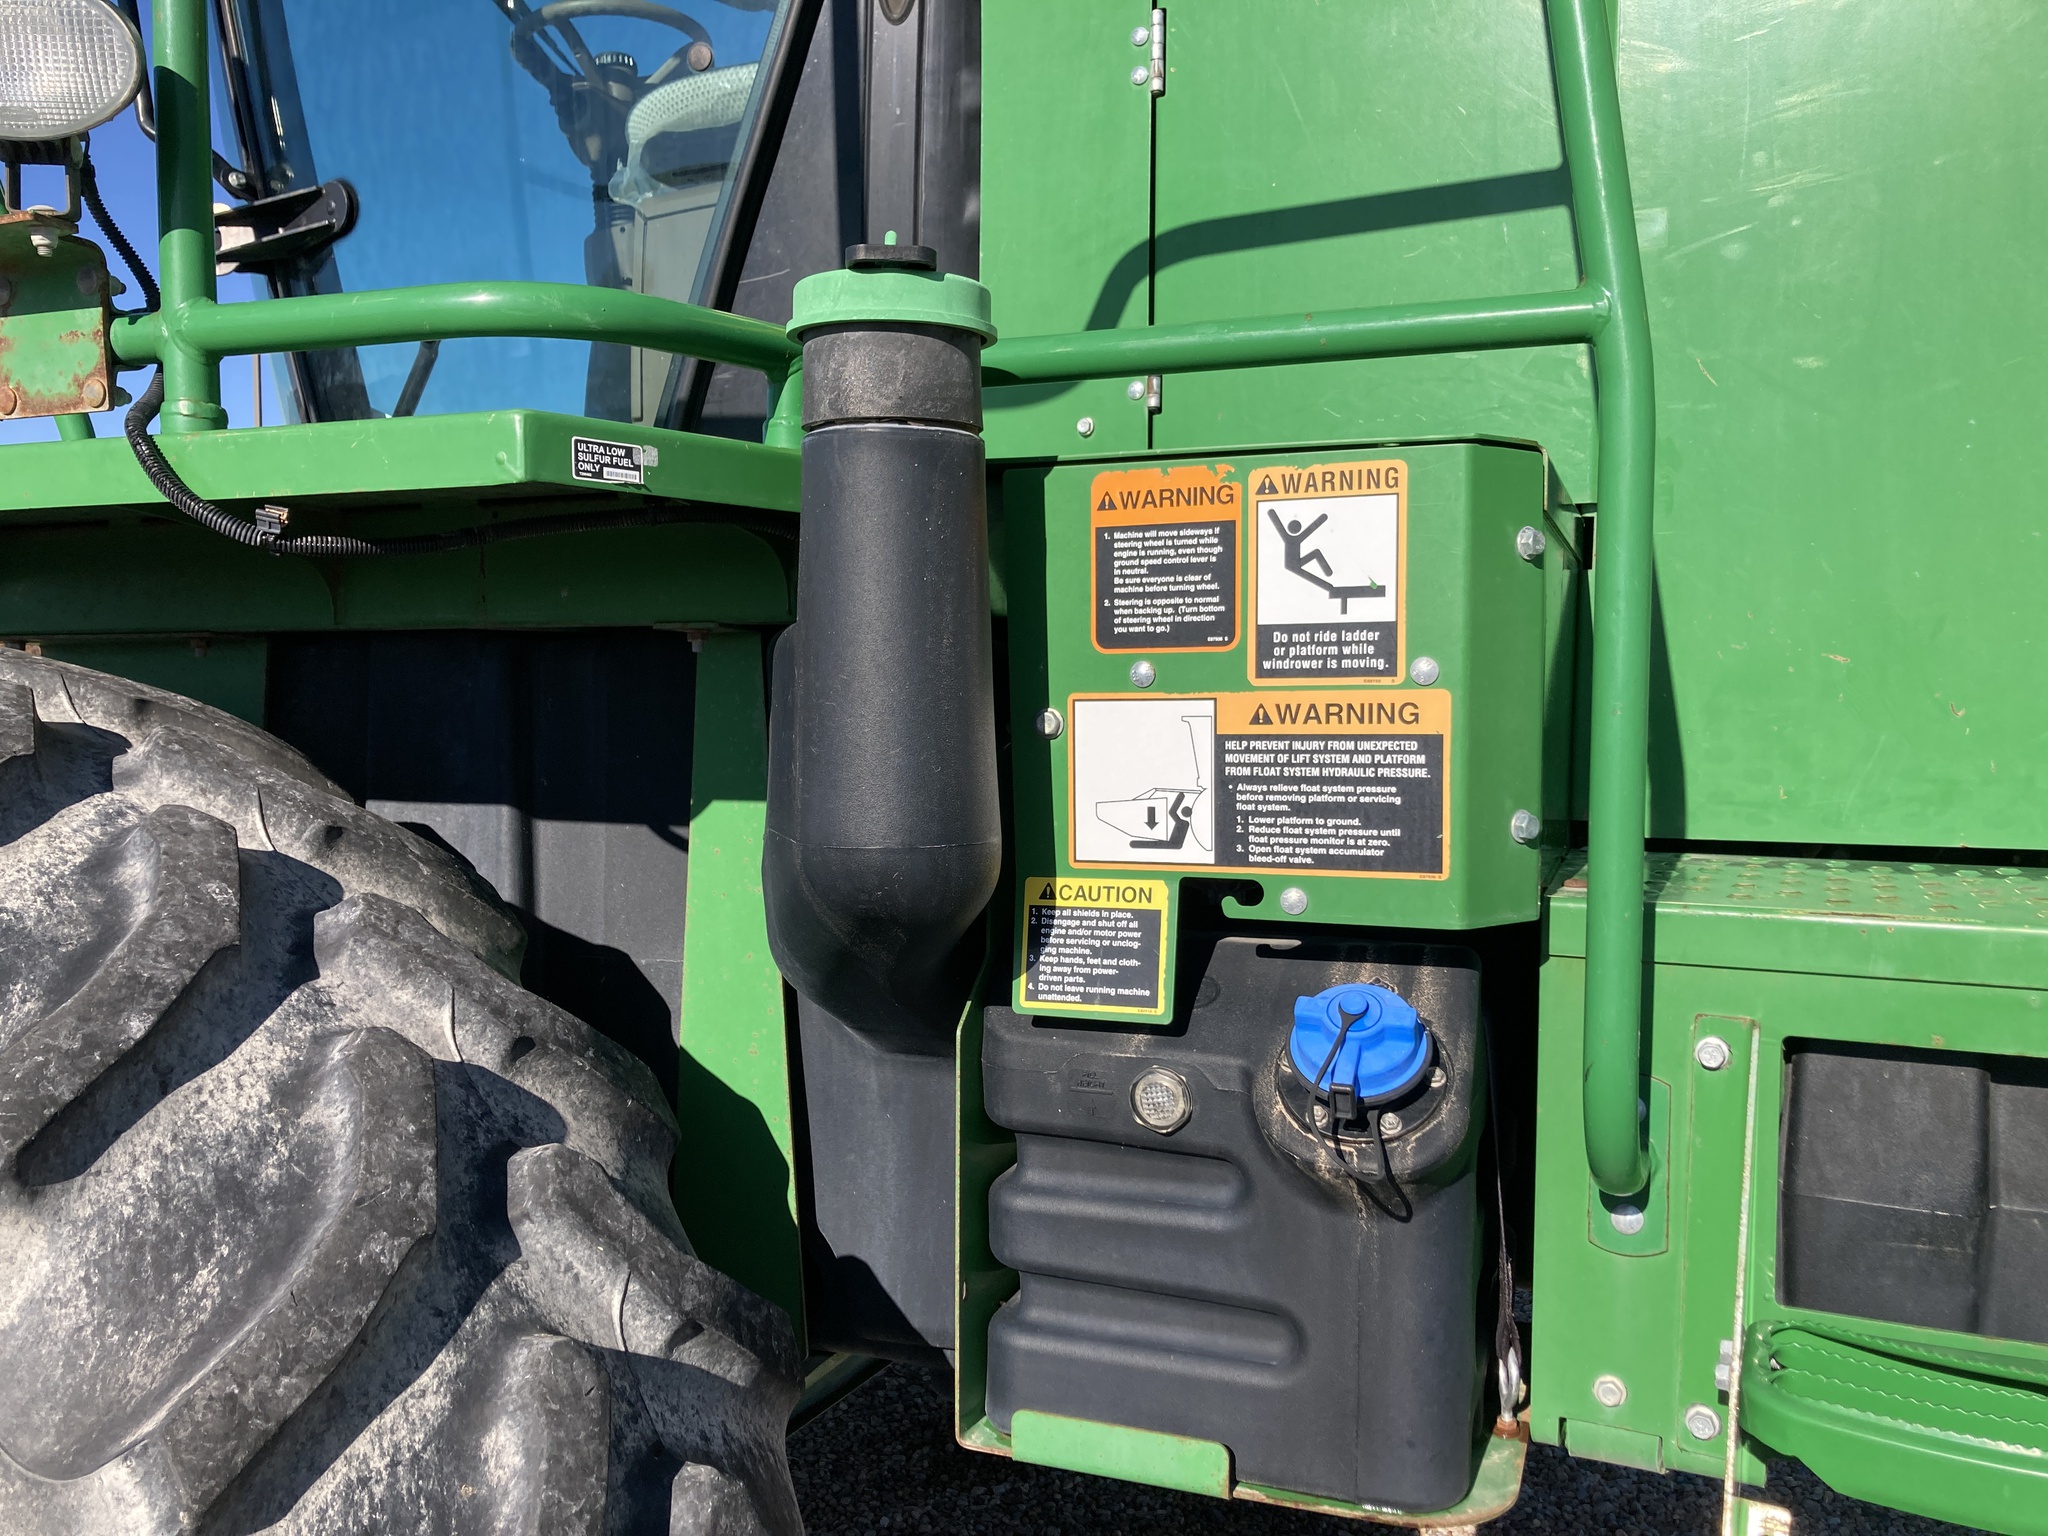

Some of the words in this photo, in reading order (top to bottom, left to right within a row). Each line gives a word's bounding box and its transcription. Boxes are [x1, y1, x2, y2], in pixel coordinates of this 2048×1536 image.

[578, 443, 604, 453] ULTRA
[606, 446, 624, 456] LOW
[578, 452, 610, 464] SULFUR
[613, 457, 634, 467] FUEL
[578, 462, 600, 472] ONLY
[1281, 466, 1398, 493] WARNING
[1119, 485, 1233, 509] WARNING
[1180, 528, 1212, 537] sideways
[1114, 540, 1141, 549] steering
[1199, 537, 1217, 545] while
[1113, 550, 1138, 559] engine
[1146, 548, 1176, 558] running,
[1196, 546, 1222, 556] though
[1114, 558, 1138, 567] ground
[1140, 557, 1161, 566] speed
[1163, 556, 1188, 564] control
[1142, 576, 1174, 585] everyone
[1169, 584, 1194, 592] turning
[1114, 598, 1142, 607] Steering
[1152, 597, 1183, 605] opposite
[1134, 606, 1161, 615] backing
[1178, 605, 1197, 615] (Turn
[1199, 605, 1224, 613] bottom
[1123, 616, 1150, 624] steering
[1114, 626, 1126, 634] you
[1274, 631, 1287, 642] Do
[1292, 631, 1309, 642] not
[1315, 630, 1336, 641] ride
[1342, 629, 1378, 641] ladder
[1273, 647, 1285, 657] or
[1289, 644, 1338, 658] platform
[1342, 644, 1374, 656] while
[1262, 658, 1323, 669] windrower
[1327, 658, 1337, 668] is
[1341, 657, 1388, 670] moving.
[1275, 702, 1419, 724] WARNING
[1225, 740, 1248, 749] HELP
[1249, 740, 1290, 749] PREVENT
[1292, 740, 1325, 750] INJURY
[1327, 740, 1354, 750] FROM
[1357, 740, 1418, 750] UNEXPECTED
[1225, 753, 1274, 762] MOVEMENT
[1277, 753, 1288, 762] OF
[1291, 754, 1310, 763] LIFT
[1312, 754, 1349, 763] SYSTEM
[1352, 754, 1371, 763] AND
[1374, 754, 1425, 764] PLATFORM
[1225, 766, 1251, 775] FROM
[1252, 766, 1281, 776] FLOAT
[1282, 766, 1320, 776] SYSTEM
[1322, 767, 1375, 776] HYDRAULIC
[1377, 767, 1430, 777] PRESSURE.
[1237, 784, 1266, 793] Always
[1270, 784, 1297, 792] relieve
[1300, 784, 1319, 793] float
[1322, 785, 1353, 794] system
[1357, 786, 1396, 794] pressure
[1236, 793, 1263, 802] before
[1265, 794, 1306, 803] removing
[1308, 794, 1345, 803] platform
[1359, 795, 1401, 804] servicing
[1257, 803, 1289, 812] system.
[1237, 816, 1244, 824] 1.
[1249, 816, 1274, 825] Lower
[1277, 817, 1312, 827] platform
[1327, 818, 1360, 827] ground.
[1248, 826, 1280, 834] Reduce
[1282, 826, 1302, 834] float
[1304, 827, 1336, 836] system
[1338, 829, 1378, 837] pressure
[1380, 828, 1400, 836] until
[1249, 835, 1267, 844] float
[1270, 837, 1307, 846] pressure
[1248, 845, 1271, 855] Open
[1273, 846, 1293, 854] float
[1294, 846, 1326, 855] system
[1328, 847, 1384, 856] accumulator
[1059, 884, 1151, 903] CAUTION
[1042, 908, 1060, 917] Keep
[1110, 910, 1133, 919] place.
[1041, 917, 1080, 927] Disengage
[1098, 919, 1115, 927] shut
[1128, 920, 1138, 928] all
[1041, 927, 1066, 937] engine
[1117, 931, 1141, 939] power
[1040, 936, 1064, 944] before
[1065, 937, 1100, 948] servicing
[1112, 939, 1140, 948] unclog-
[1040, 946, 1056, 955] ging
[1058, 946, 1092, 954] machine.
[1039, 955, 1058, 965] Keep
[1060, 956, 1085, 966] hands,
[1118, 958, 1140, 966] cloth-
[1040, 965, 1050, 975] ing
[1053, 966, 1071, 974] away
[1074, 967, 1090, 975] from
[1093, 968, 1118, 976] power-
[1038, 974, 1062, 983] driven
[1064, 975, 1085, 985] parts.
[1050, 984, 1062, 993] not
[1064, 985, 1084, 994] leave
[1086, 986, 1115, 995] running
[1117, 988, 1150, 996] machine
